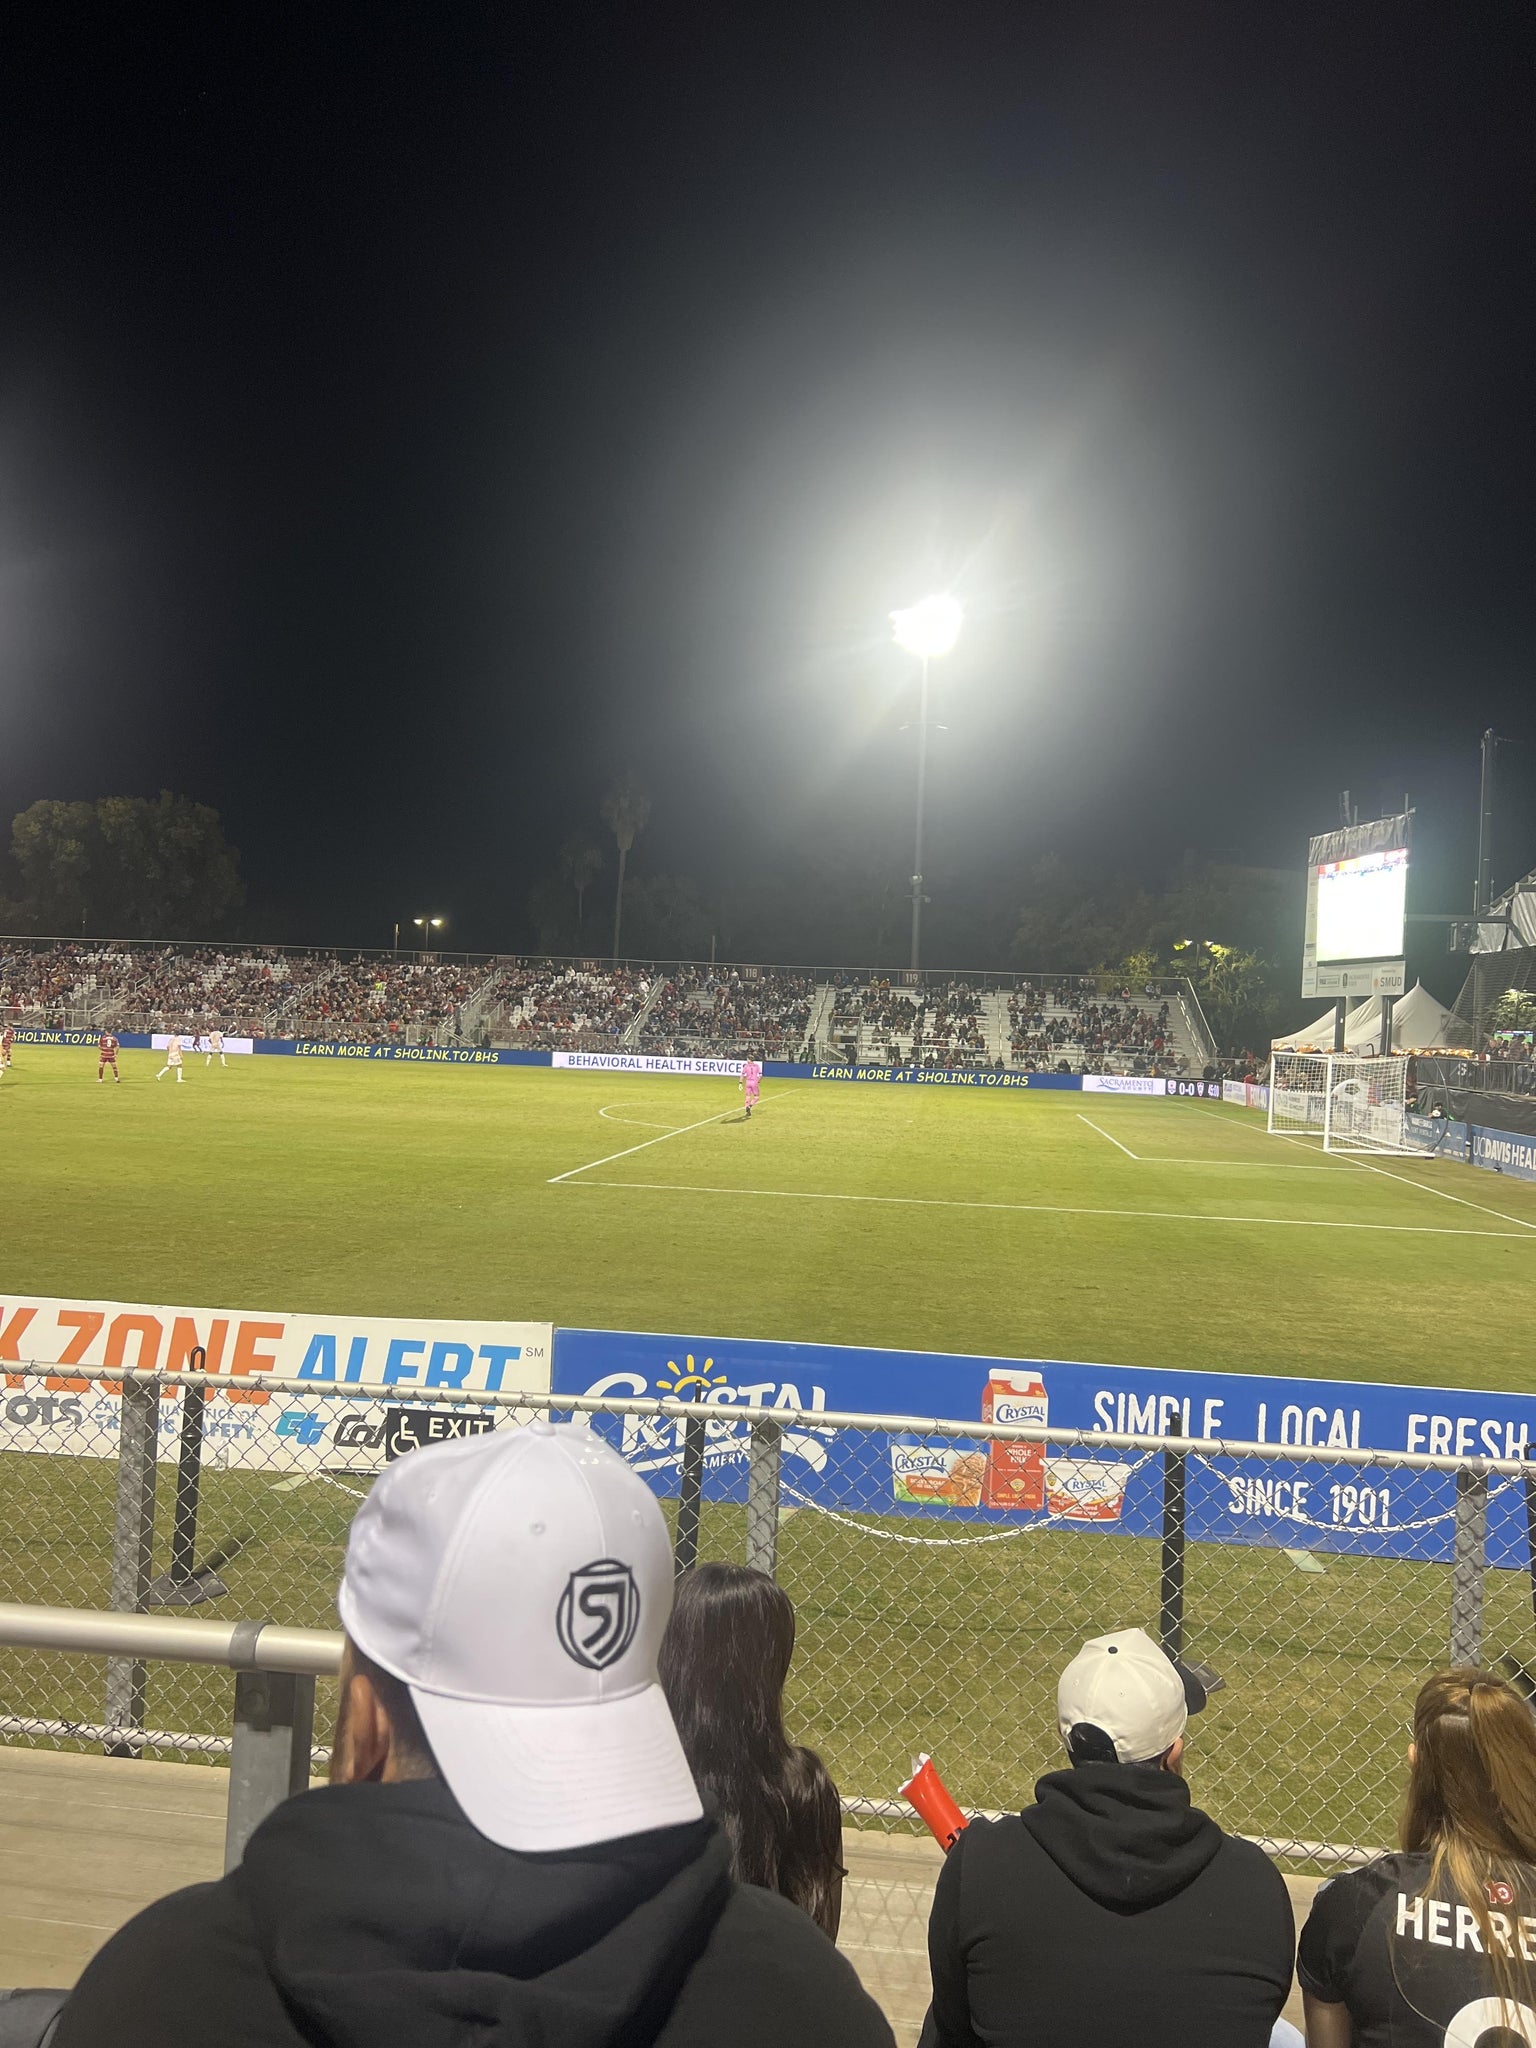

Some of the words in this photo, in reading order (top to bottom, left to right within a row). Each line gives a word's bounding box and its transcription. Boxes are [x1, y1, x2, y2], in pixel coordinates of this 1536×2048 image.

[582, 961, 595, 970] 117
[745, 967, 758, 978] 118
[905, 973, 918, 983] 119
[1380, 976, 1402, 987] SMUD
[13, 1030, 101, 1044] SHOLINK.TO/BH
[106, 1039, 112, 1048] 9
[295, 1043, 335, 1056] LEARN
[337, 1045, 371, 1058] MORE
[374, 1046, 392, 1059] AT
[393, 1047, 499, 1063] SHOLINK.TO/BHS
[568, 1055, 643, 1069] BEHAVIORAL
[646, 1058, 692, 1072] HEALTH
[695, 1060, 746, 1074] SERVICE
[812, 1066, 853, 1079] LEARN
[856, 1068, 893, 1081] MORE
[895, 1070, 914, 1082] AT
[916, 1070, 1029, 1087] SHOLINK.TO/BHS
[1099, 1076, 1153, 1088] SACRAMENTO
[1179, 1082, 1195, 1096] 0-0
[44, 1309, 286, 1405] ZONE
[290, 1334, 522, 1410] ALERT
[525, 1346, 544, 1358] SM
[5, 1394, 84, 1426] OTS
[570, 1372, 838, 1452] CRYSTAL
[995, 1402, 1046, 1424] CRYSTAL
[201, 1421, 255, 1440] AFETY
[428, 1416, 490, 1439] EXIT
[1093, 1390, 1225, 1440] SIMPLE
[1257, 1402, 1361, 1449] LOCAL
[1406, 1413, 1529, 1461] FRESH
[1006, 1448, 1032, 1457] WHOLE
[895, 1453, 948, 1474] CRYSTAL
[1063, 1477, 1108, 1493] CRYSTAL
[1228, 1476, 1310, 1519] SINCE
[1328, 1484, 1391, 1528] 1901
